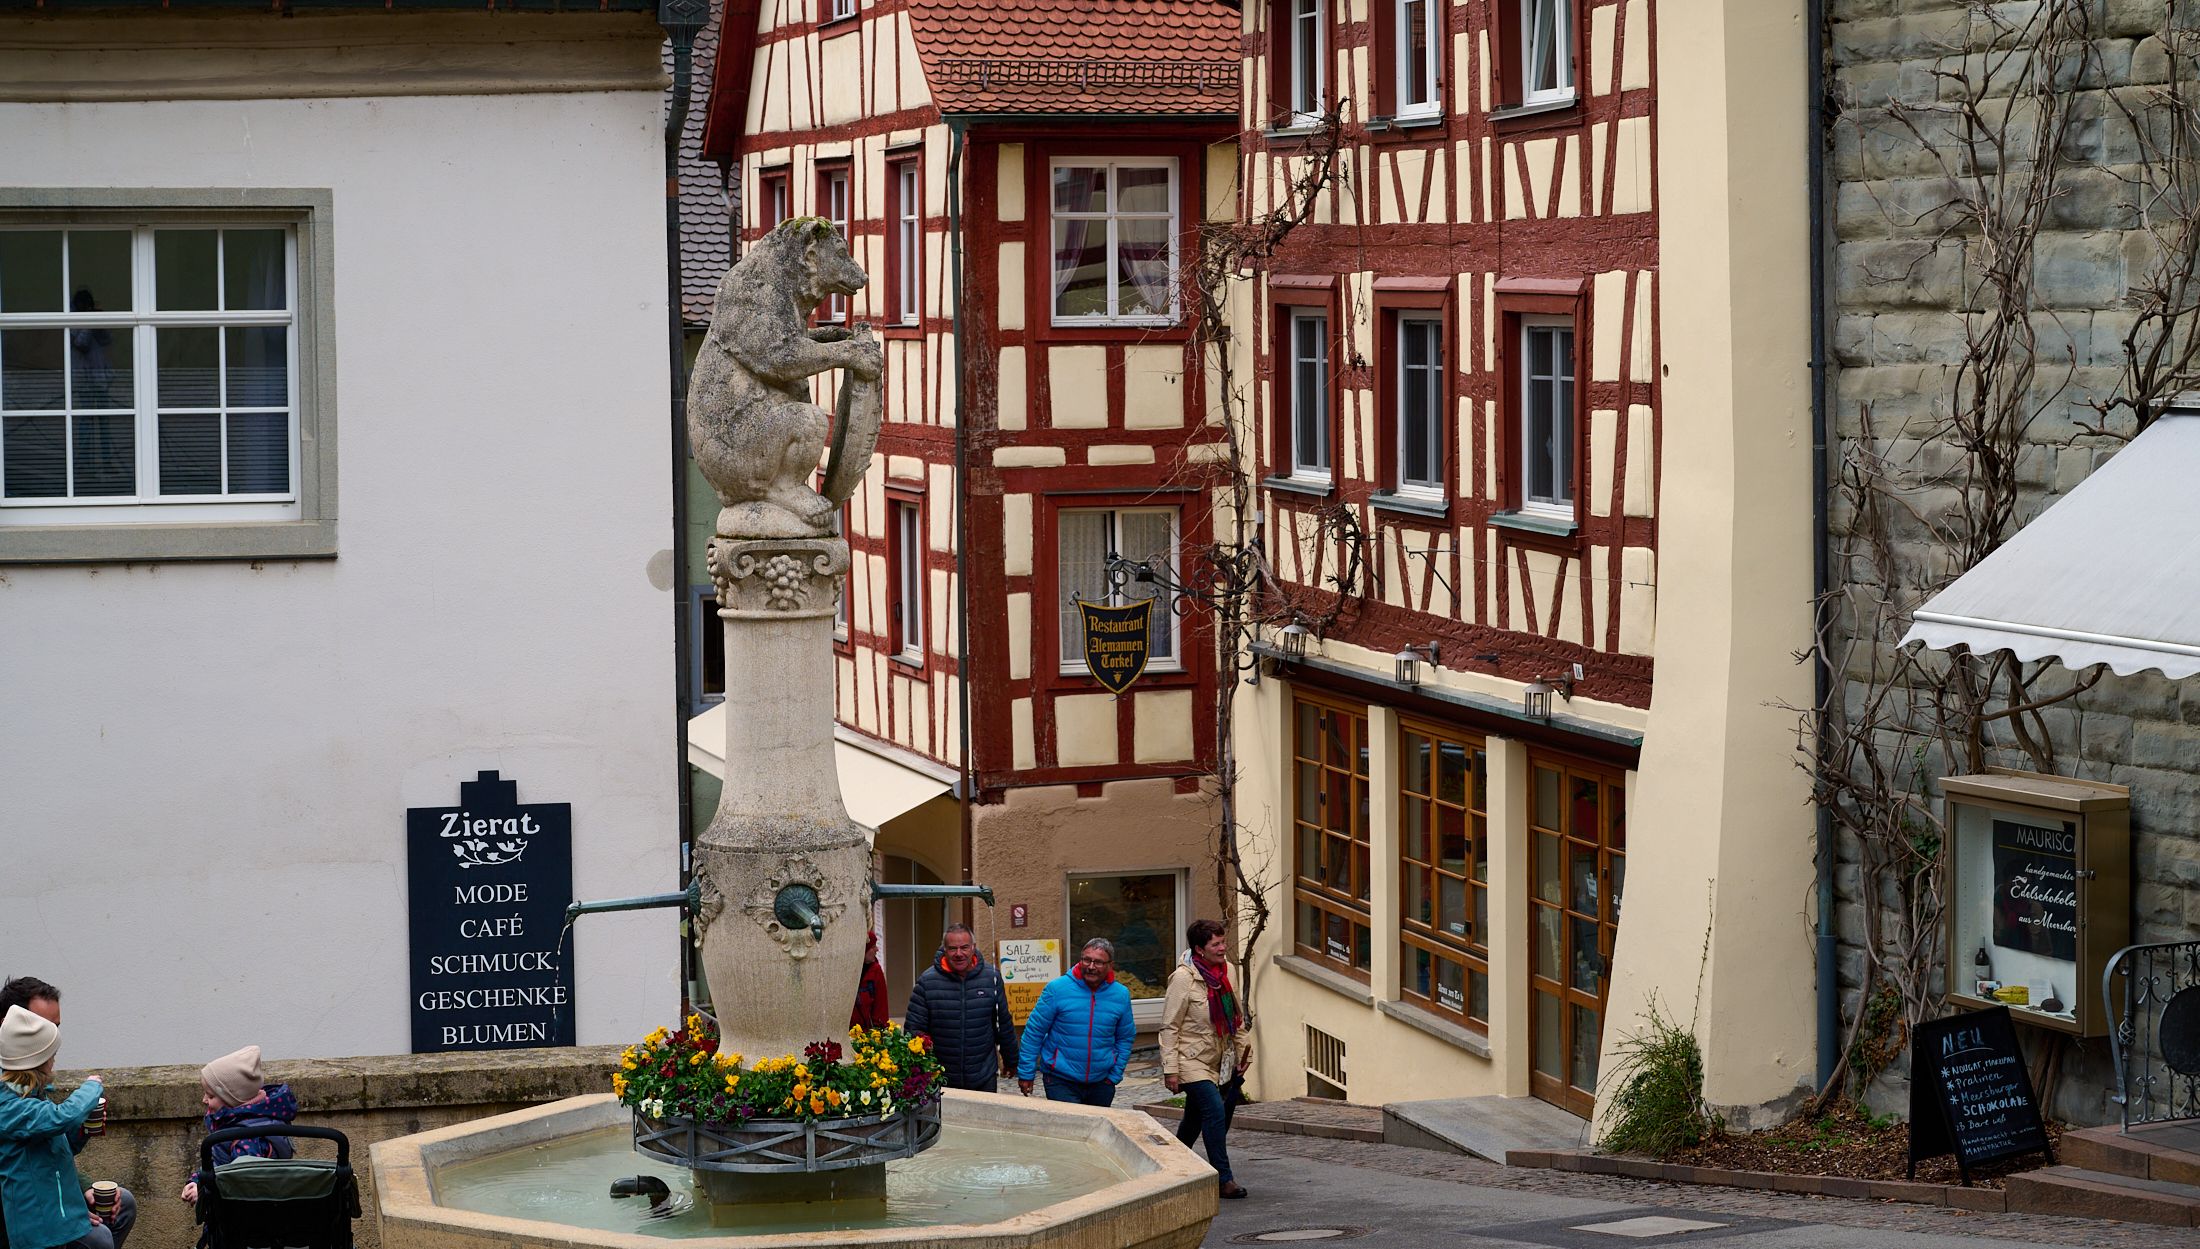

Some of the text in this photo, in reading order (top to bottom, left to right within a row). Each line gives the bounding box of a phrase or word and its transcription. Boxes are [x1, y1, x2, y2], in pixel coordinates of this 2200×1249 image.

[1089, 615, 1144, 633] Restaurant
[1089, 637, 1144, 653] Alemannen
[1101, 653, 1134, 668] Torkel
[440, 812, 540, 837] Zierat
[2016, 827, 2076, 853] MAURISC
[2024, 863, 2076, 881] handgemachte
[455, 883, 528, 905] MODE
[460, 913, 524, 938] CAFÉ
[2018, 915, 2032, 924] aus
[1006, 944, 1030, 956] SALZ
[430, 952, 555, 975] SCHMUCK
[419, 986, 568, 1011] GESCHENKE
[441, 1022, 547, 1045] BLUMEN
[1942, 1027, 1985, 1055] NEU
[1954, 1072, 2004, 1089] Pralinen
[1962, 1096, 2029, 1117] SCHOKOLADE
